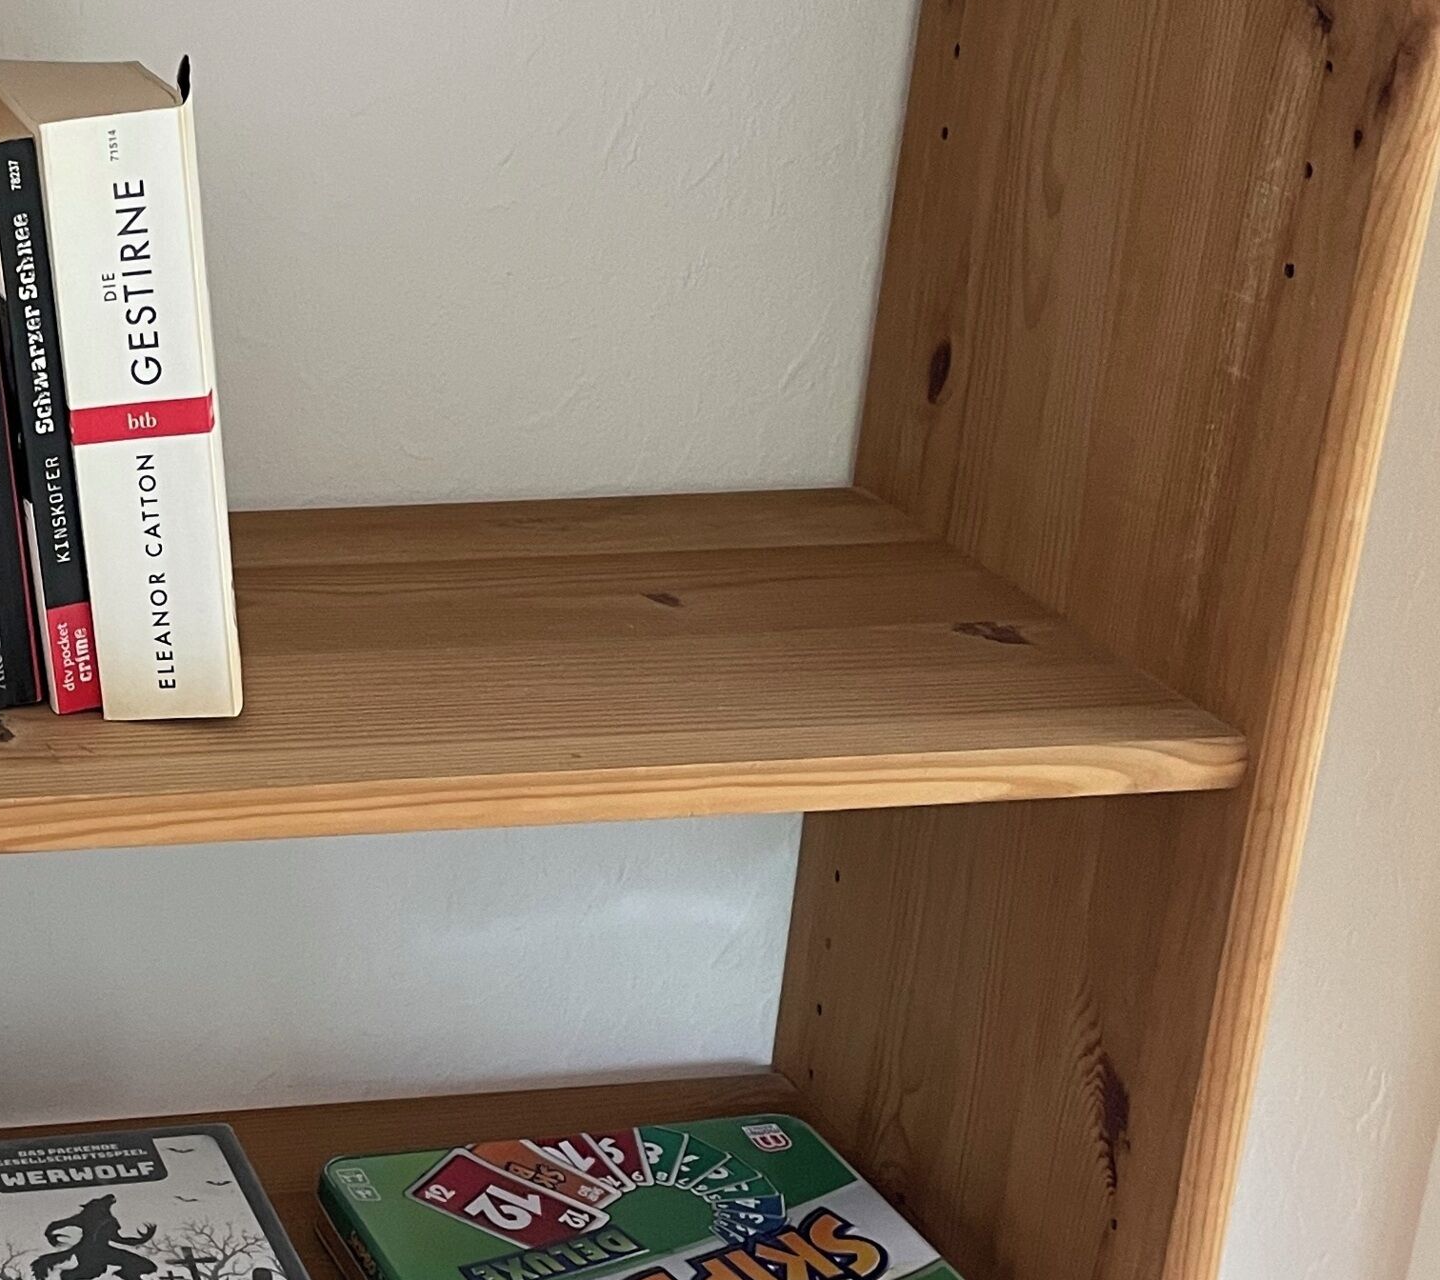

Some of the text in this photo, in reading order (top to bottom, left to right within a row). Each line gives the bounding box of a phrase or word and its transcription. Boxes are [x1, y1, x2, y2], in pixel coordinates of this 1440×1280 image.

[107, 129, 120, 162] 71514
[7, 159, 22, 191] 78237
[101, 272, 118, 302] DIE
[112, 178, 163, 386] GESTIRNE
[13, 213, 71, 563] KINSKOFER Schwarzer Schnee
[127, 411, 158, 431] btb
[135, 453, 177, 690] ELEANOR CATTON
[56, 622, 76, 692] dtv pocket
[73, 626, 93, 683] crime
[47, 1143, 119, 1156] PACKENDE
[0, 1161, 155, 1187] WERWOLF
[464, 1184, 543, 1230] 12
[558, 1208, 591, 1229] 12
